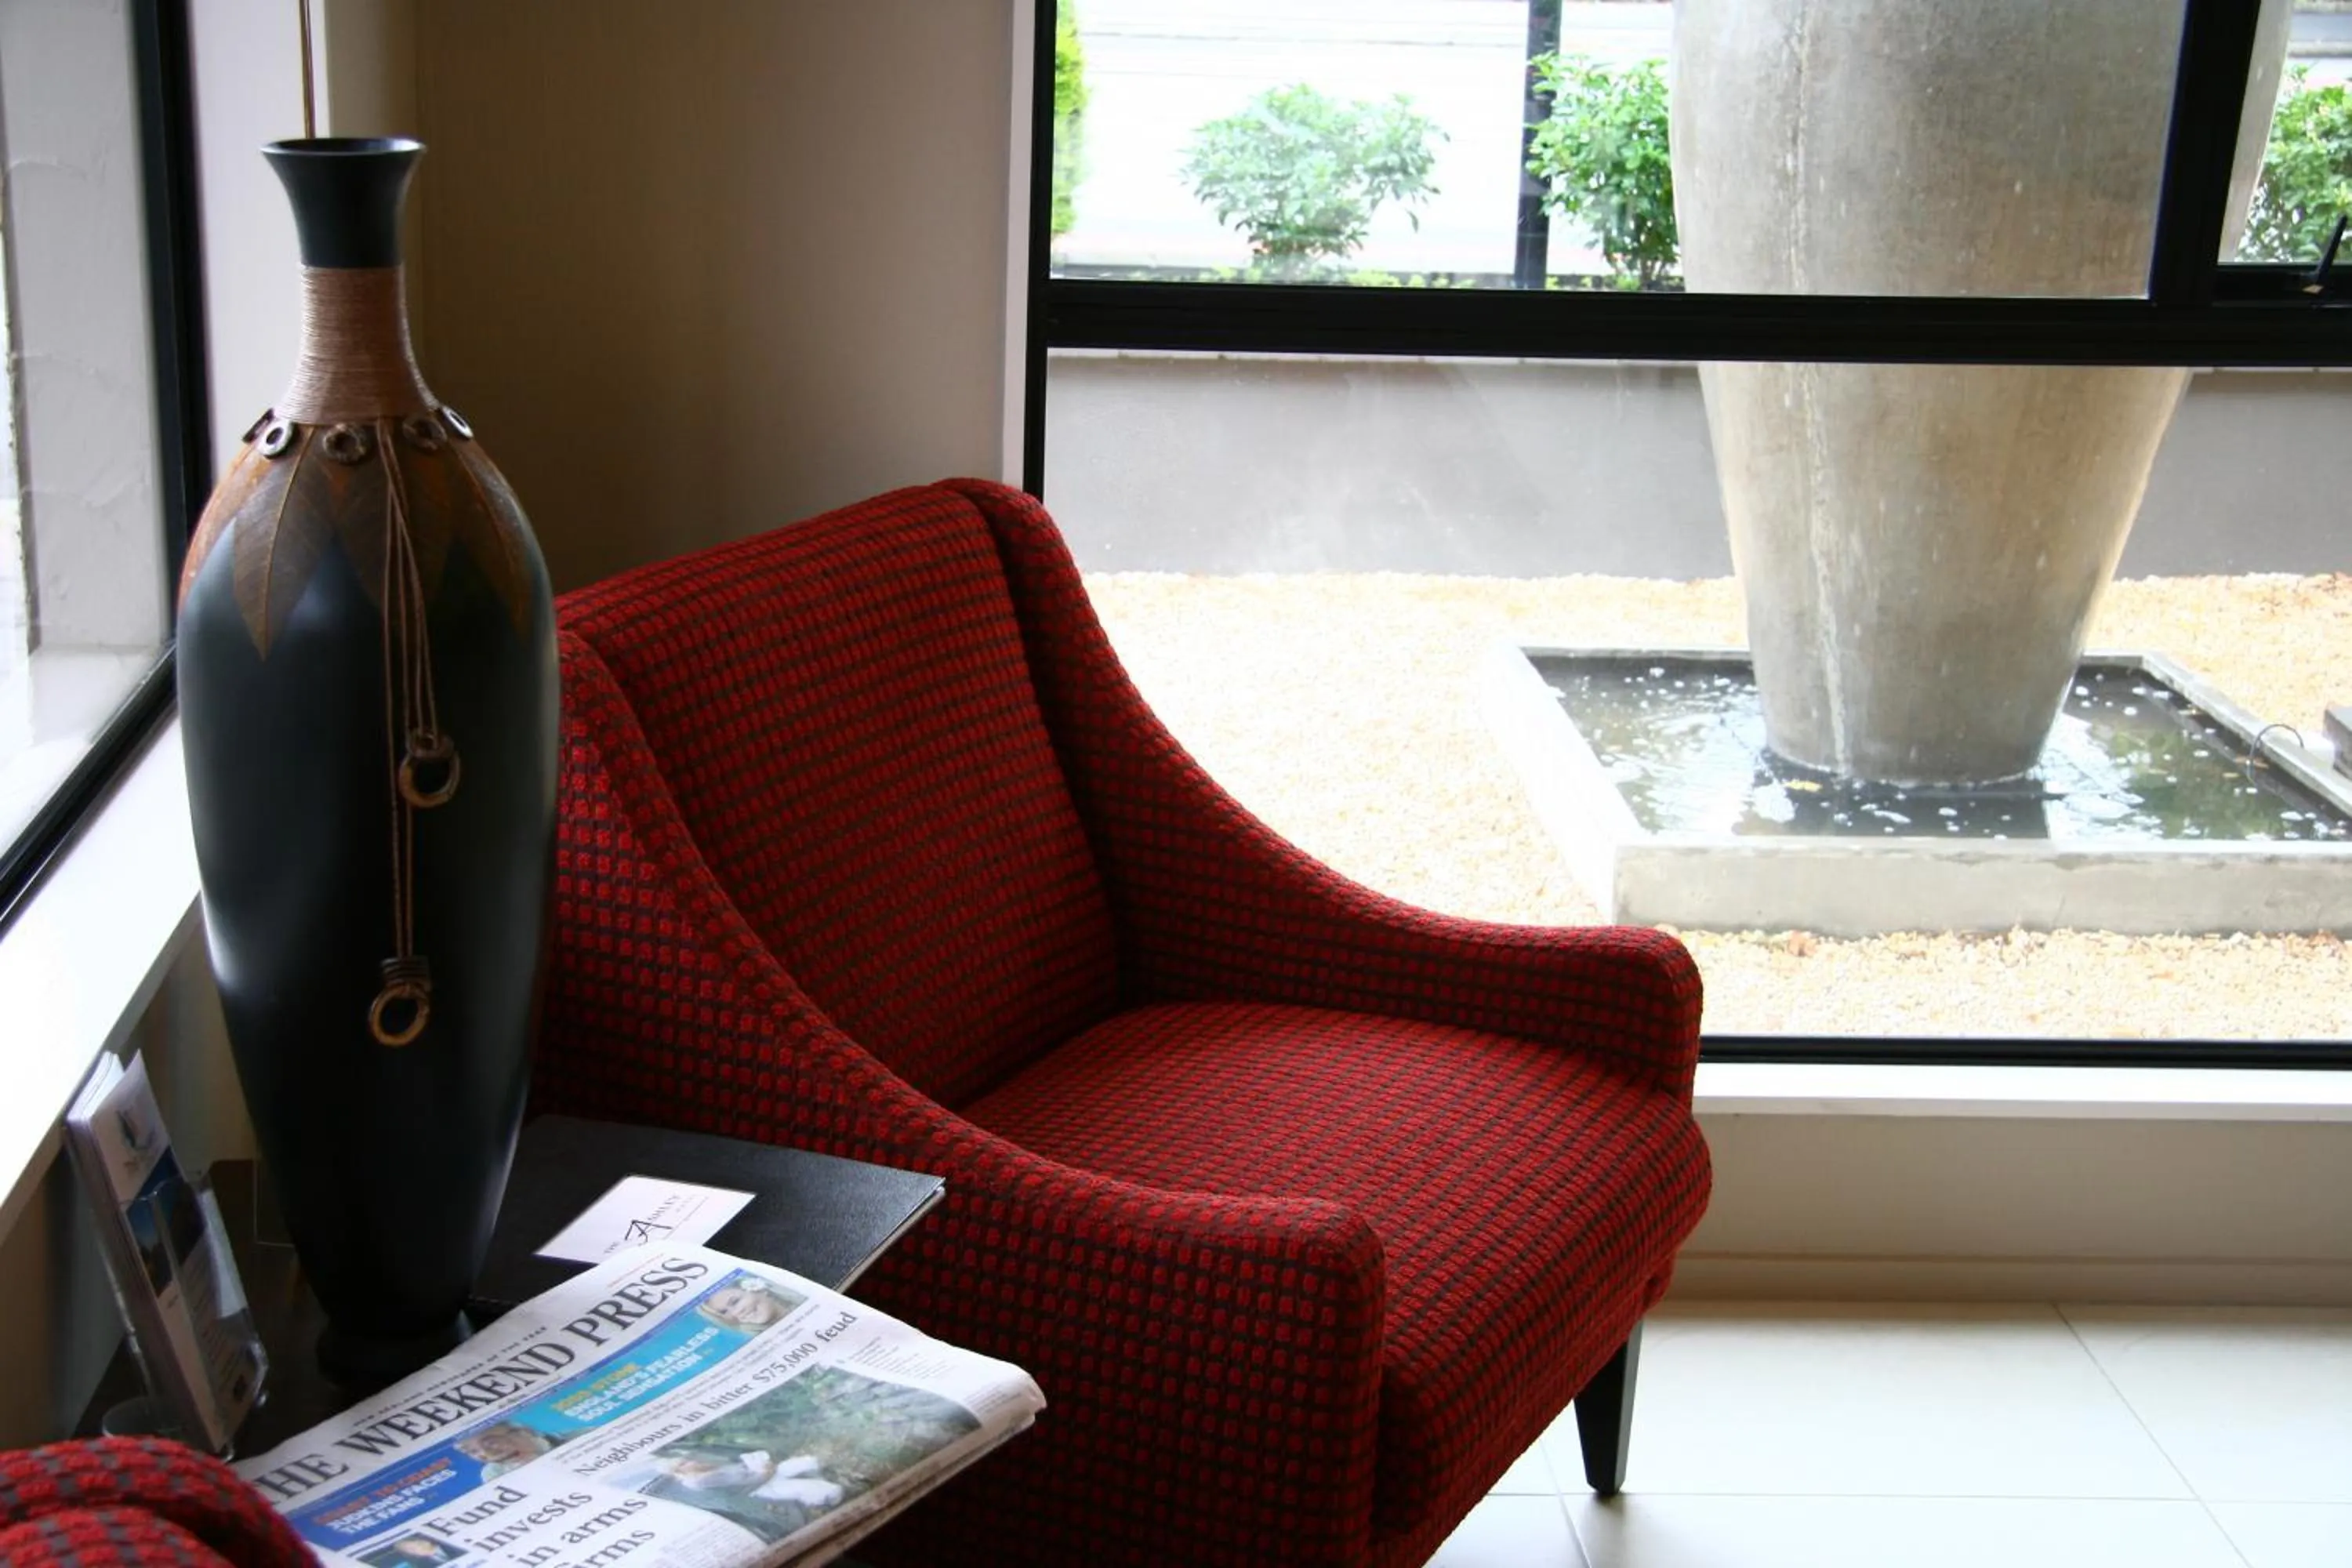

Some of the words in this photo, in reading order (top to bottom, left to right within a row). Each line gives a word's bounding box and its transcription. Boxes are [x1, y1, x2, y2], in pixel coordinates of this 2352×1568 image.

[644, 1325, 722, 1374] FEARLESS
[254, 1453, 350, 1503] HE
[333, 1341, 575, 1456] WEEKEND
[561, 1258, 709, 1347] PRESS
[574, 1424, 682, 1475] Neighbours
[679, 1409, 706, 1424] in
[701, 1384, 753, 1410] bitter
[752, 1342, 818, 1385] $75,000
[814, 1311, 858, 1343] feud
[424, 1485, 528, 1537] Fund
[464, 1492, 593, 1552] invests
[507, 1545, 562, 1568] in
[560, 1496, 649, 1543] arms
[554, 1530, 655, 1568] rms
